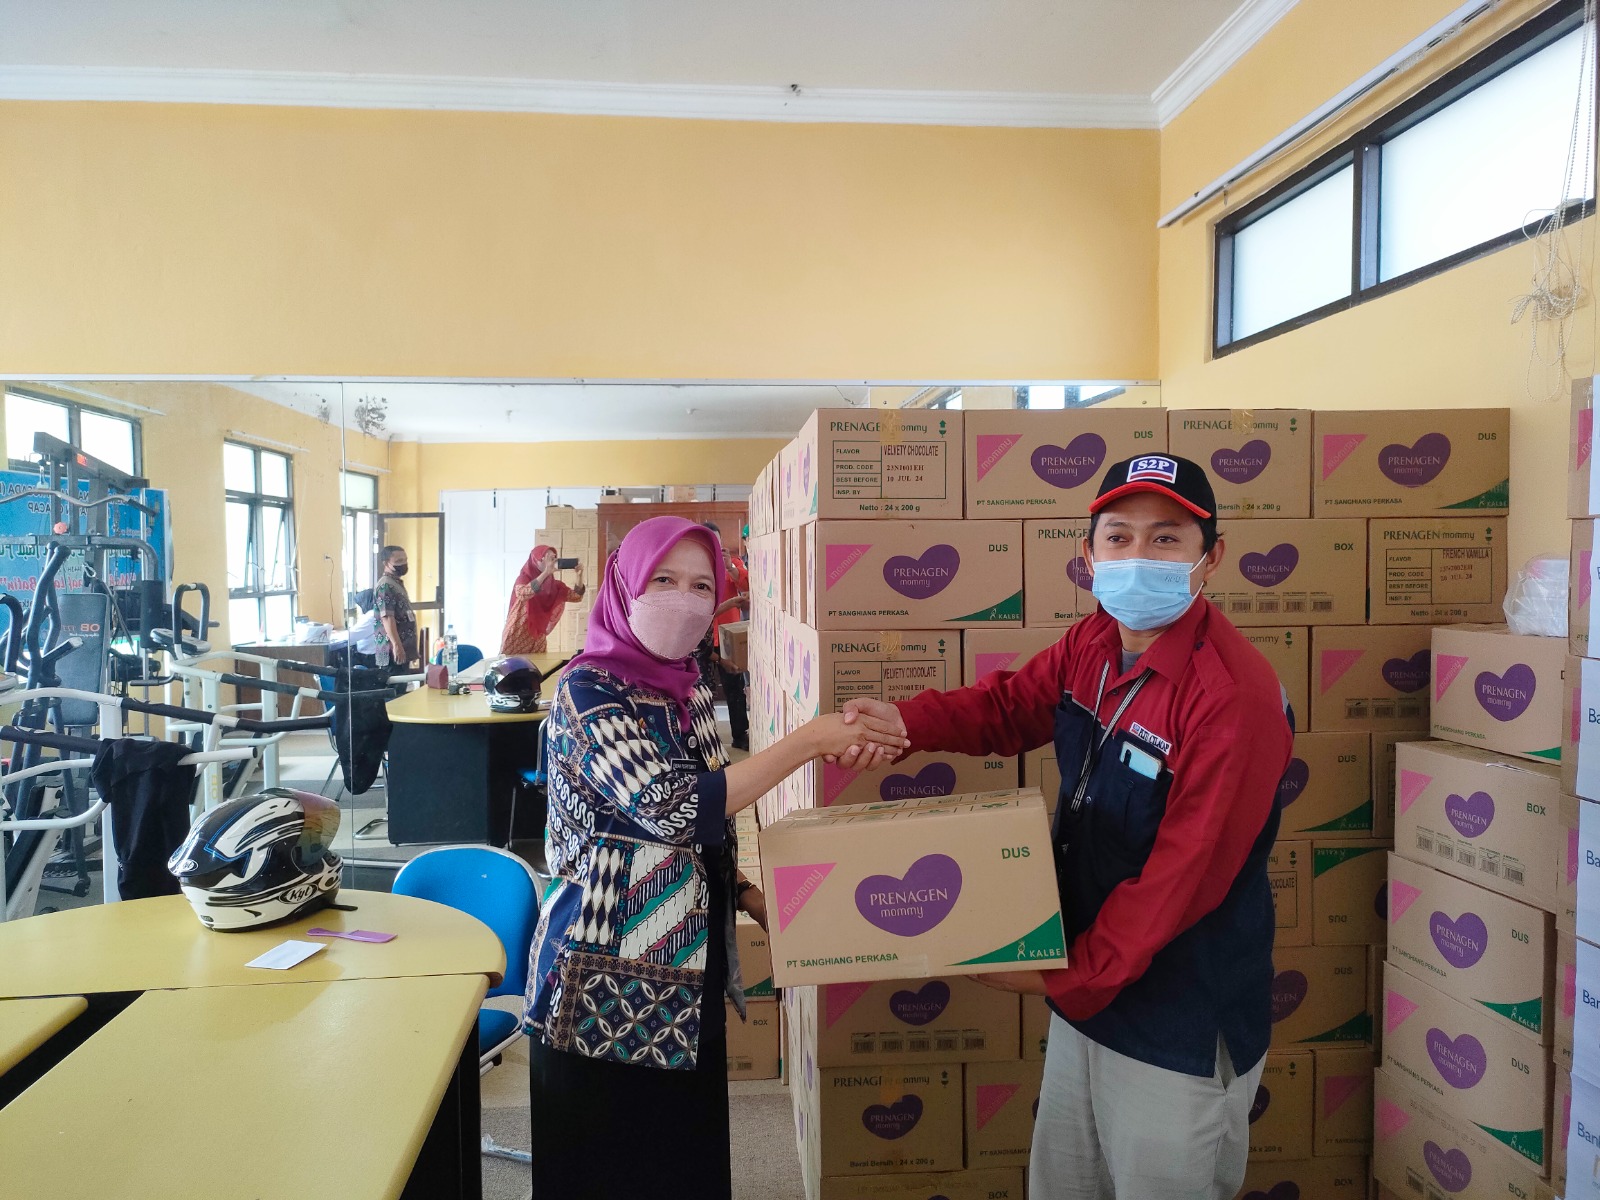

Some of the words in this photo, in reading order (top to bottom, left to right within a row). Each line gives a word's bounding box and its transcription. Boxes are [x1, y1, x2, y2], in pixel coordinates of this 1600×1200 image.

[1183, 420, 1233, 430] PRENAGE
[1252, 422, 1279, 431] ommy
[1133, 430, 1154, 439] DUS
[1477, 432, 1497, 441] DUS
[884, 444, 907, 456] VELVETY
[907, 445, 939, 456] CHOCOLATE
[981, 437, 1013, 471] mommy
[1041, 456, 1095, 466] PRENAGEN
[1137, 459, 1170, 471] S2P
[1218, 458, 1263, 466] PRENAGEN
[1387, 456, 1441, 466] PRENAGEN
[1047, 467, 1078, 476] mommy
[1223, 467, 1248, 475] mommy
[1383, 530, 1440, 540] PRENAGEN
[1442, 532, 1475, 541] mommy
[988, 543, 1009, 552] DUS
[1334, 543, 1354, 551] BOX
[830, 547, 863, 581] mommy
[1247, 565, 1290, 573] PRENAGEN
[893, 567, 949, 577] PRENAGEN
[899, 578, 931, 588] mommy
[831, 643, 881, 653] PRENAGE
[900, 644, 927, 653] ommy
[883, 667, 905, 680] VELVETY
[906, 666, 937, 678] CHOCOLATE
[1438, 660, 1462, 691] mommy
[1482, 684, 1527, 700] PRENAGEN
[1487, 697, 1512, 710] mommy
[984, 761, 1004, 769] DUS
[890, 785, 945, 796] PRENAGEN
[1526, 802, 1547, 816] BOX
[1451, 808, 1487, 826] PRENAGEN
[1001, 846, 1031, 859] DUS
[782, 869, 825, 917] mommy
[869, 887, 948, 906] PRENAGEN
[880, 905, 924, 919] mommy
[1328, 914, 1348, 923] DUS
[1436, 924, 1479, 952] PRENAGEN
[1511, 929, 1529, 944] DUS
[1440, 938, 1464, 957] mommy
[1029, 948, 1062, 959] KALBE
[786, 960, 798, 969] PT
[799, 956, 854, 967] SANGHIANG
[855, 953, 899, 963] PERKASA
[1334, 966, 1353, 975] DUS
[897, 1003, 943, 1012] PRENAGEN
[1518, 1016, 1538, 1030] KALBE
[1433, 1040, 1478, 1074] PRENAGEN
[1511, 1057, 1530, 1075] DUS
[903, 1076, 930, 1085] ommy
[870, 1113, 915, 1122] PRENAGEN
[988, 1191, 1008, 1200] BOX
[1508, 1182, 1528, 1199] BOX
